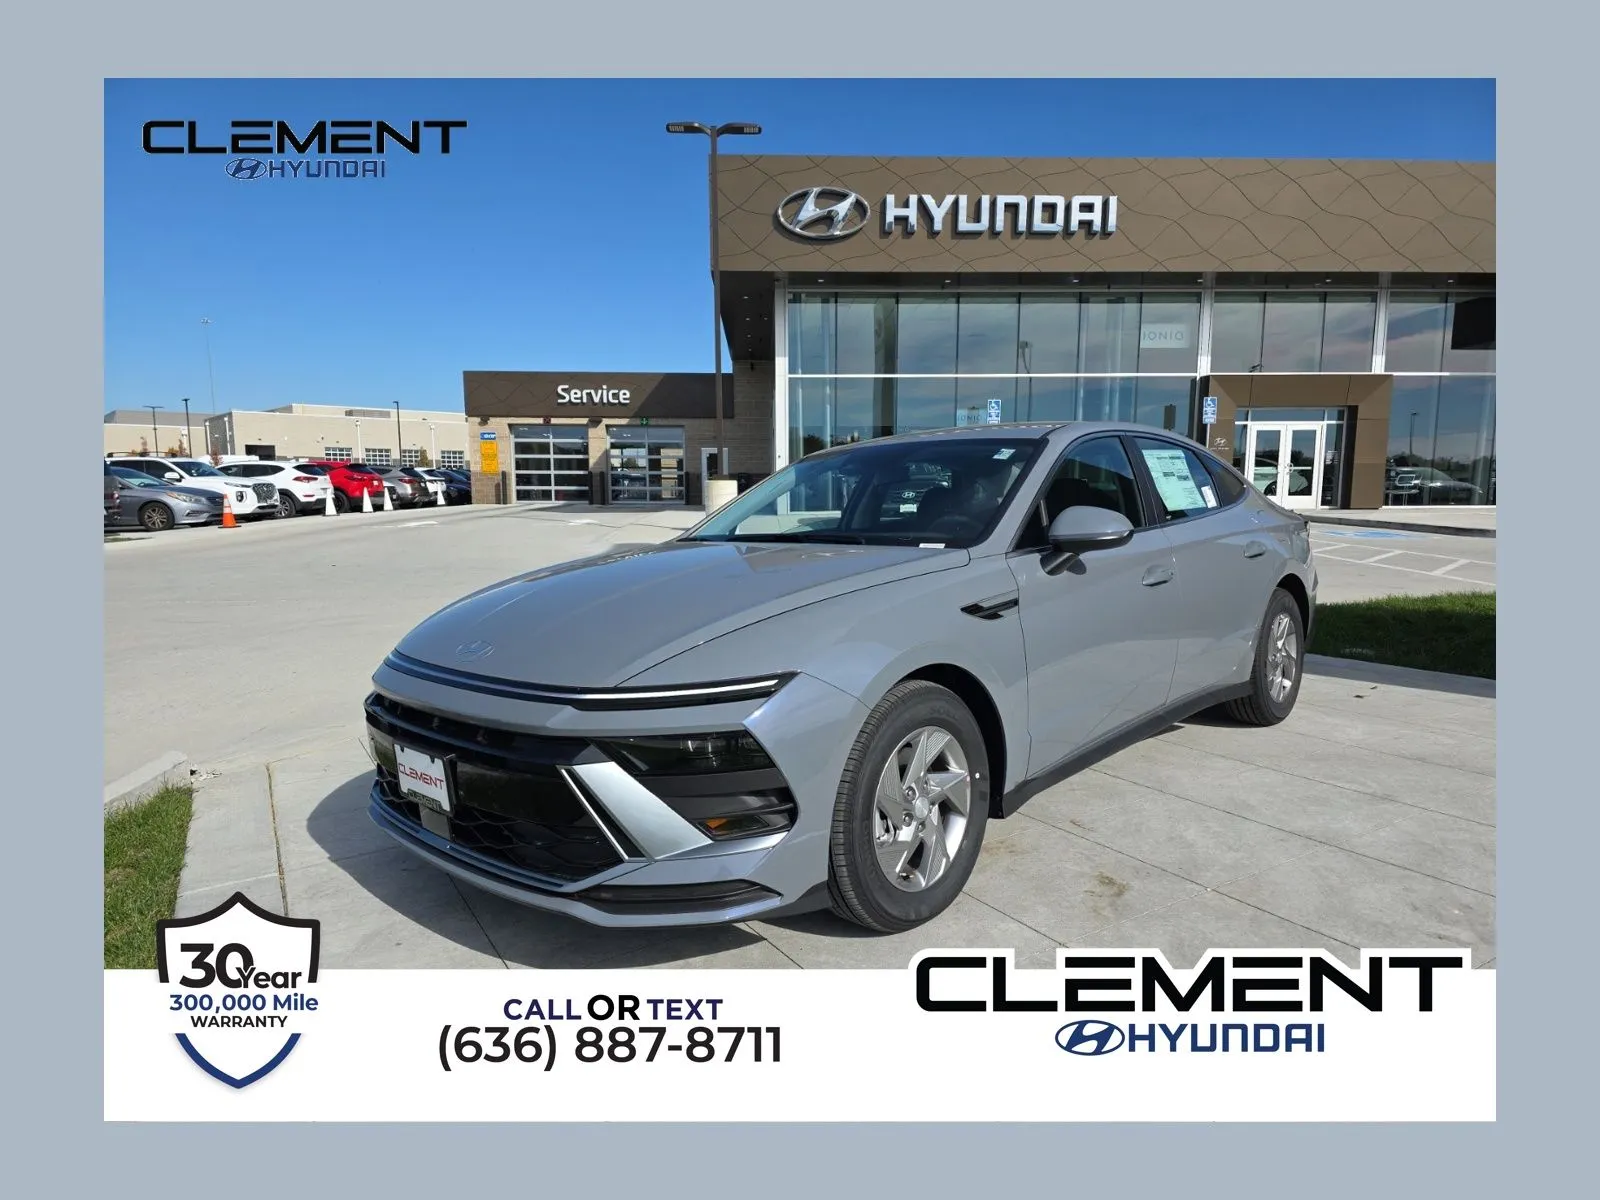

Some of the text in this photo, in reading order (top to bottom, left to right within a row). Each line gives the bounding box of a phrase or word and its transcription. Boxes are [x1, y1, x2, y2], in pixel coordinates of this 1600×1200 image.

[884, 194, 1118, 235] HYUNDAI
[557, 384, 631, 404] Service
[398, 763, 445, 790] CLEMENT
